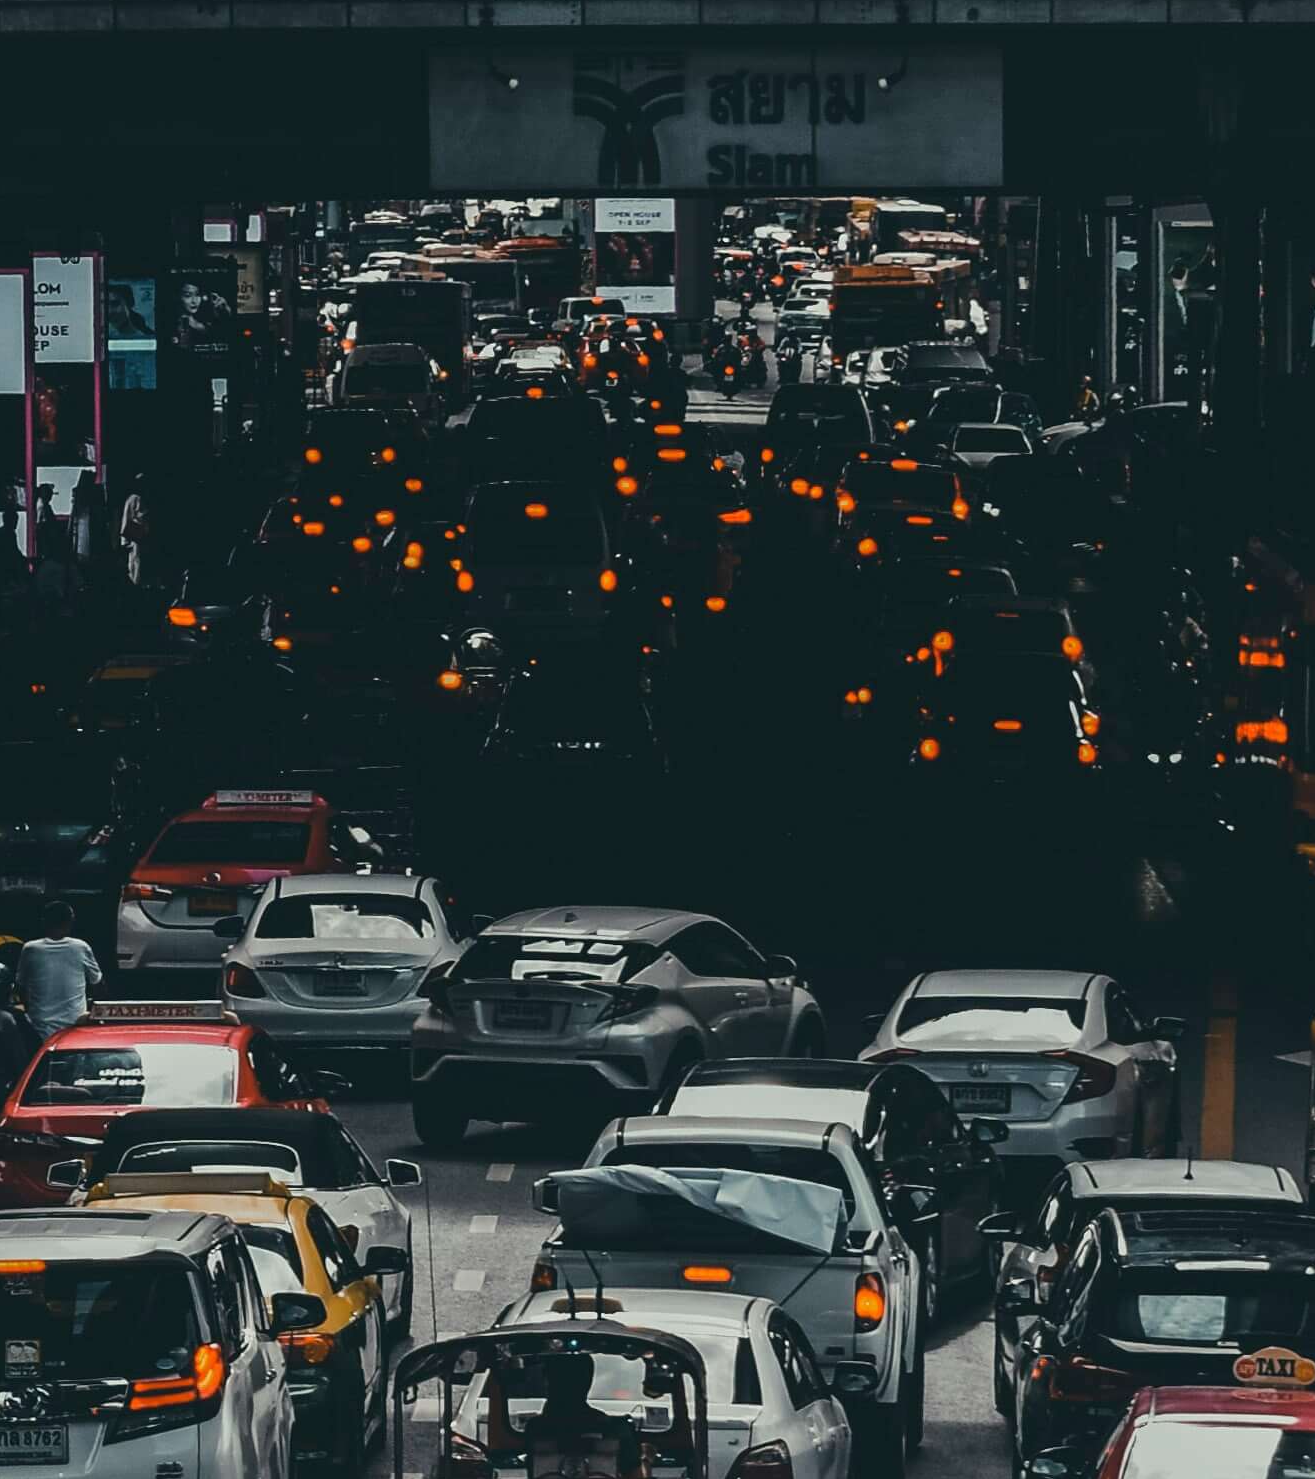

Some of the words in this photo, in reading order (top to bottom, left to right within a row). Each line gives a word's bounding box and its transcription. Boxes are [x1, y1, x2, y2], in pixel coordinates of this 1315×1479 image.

[707, 71, 866, 124] สยาม
[106, 1005, 196, 1019] TAXI-METER
[1255, 1357, 1297, 1377] TAXI
